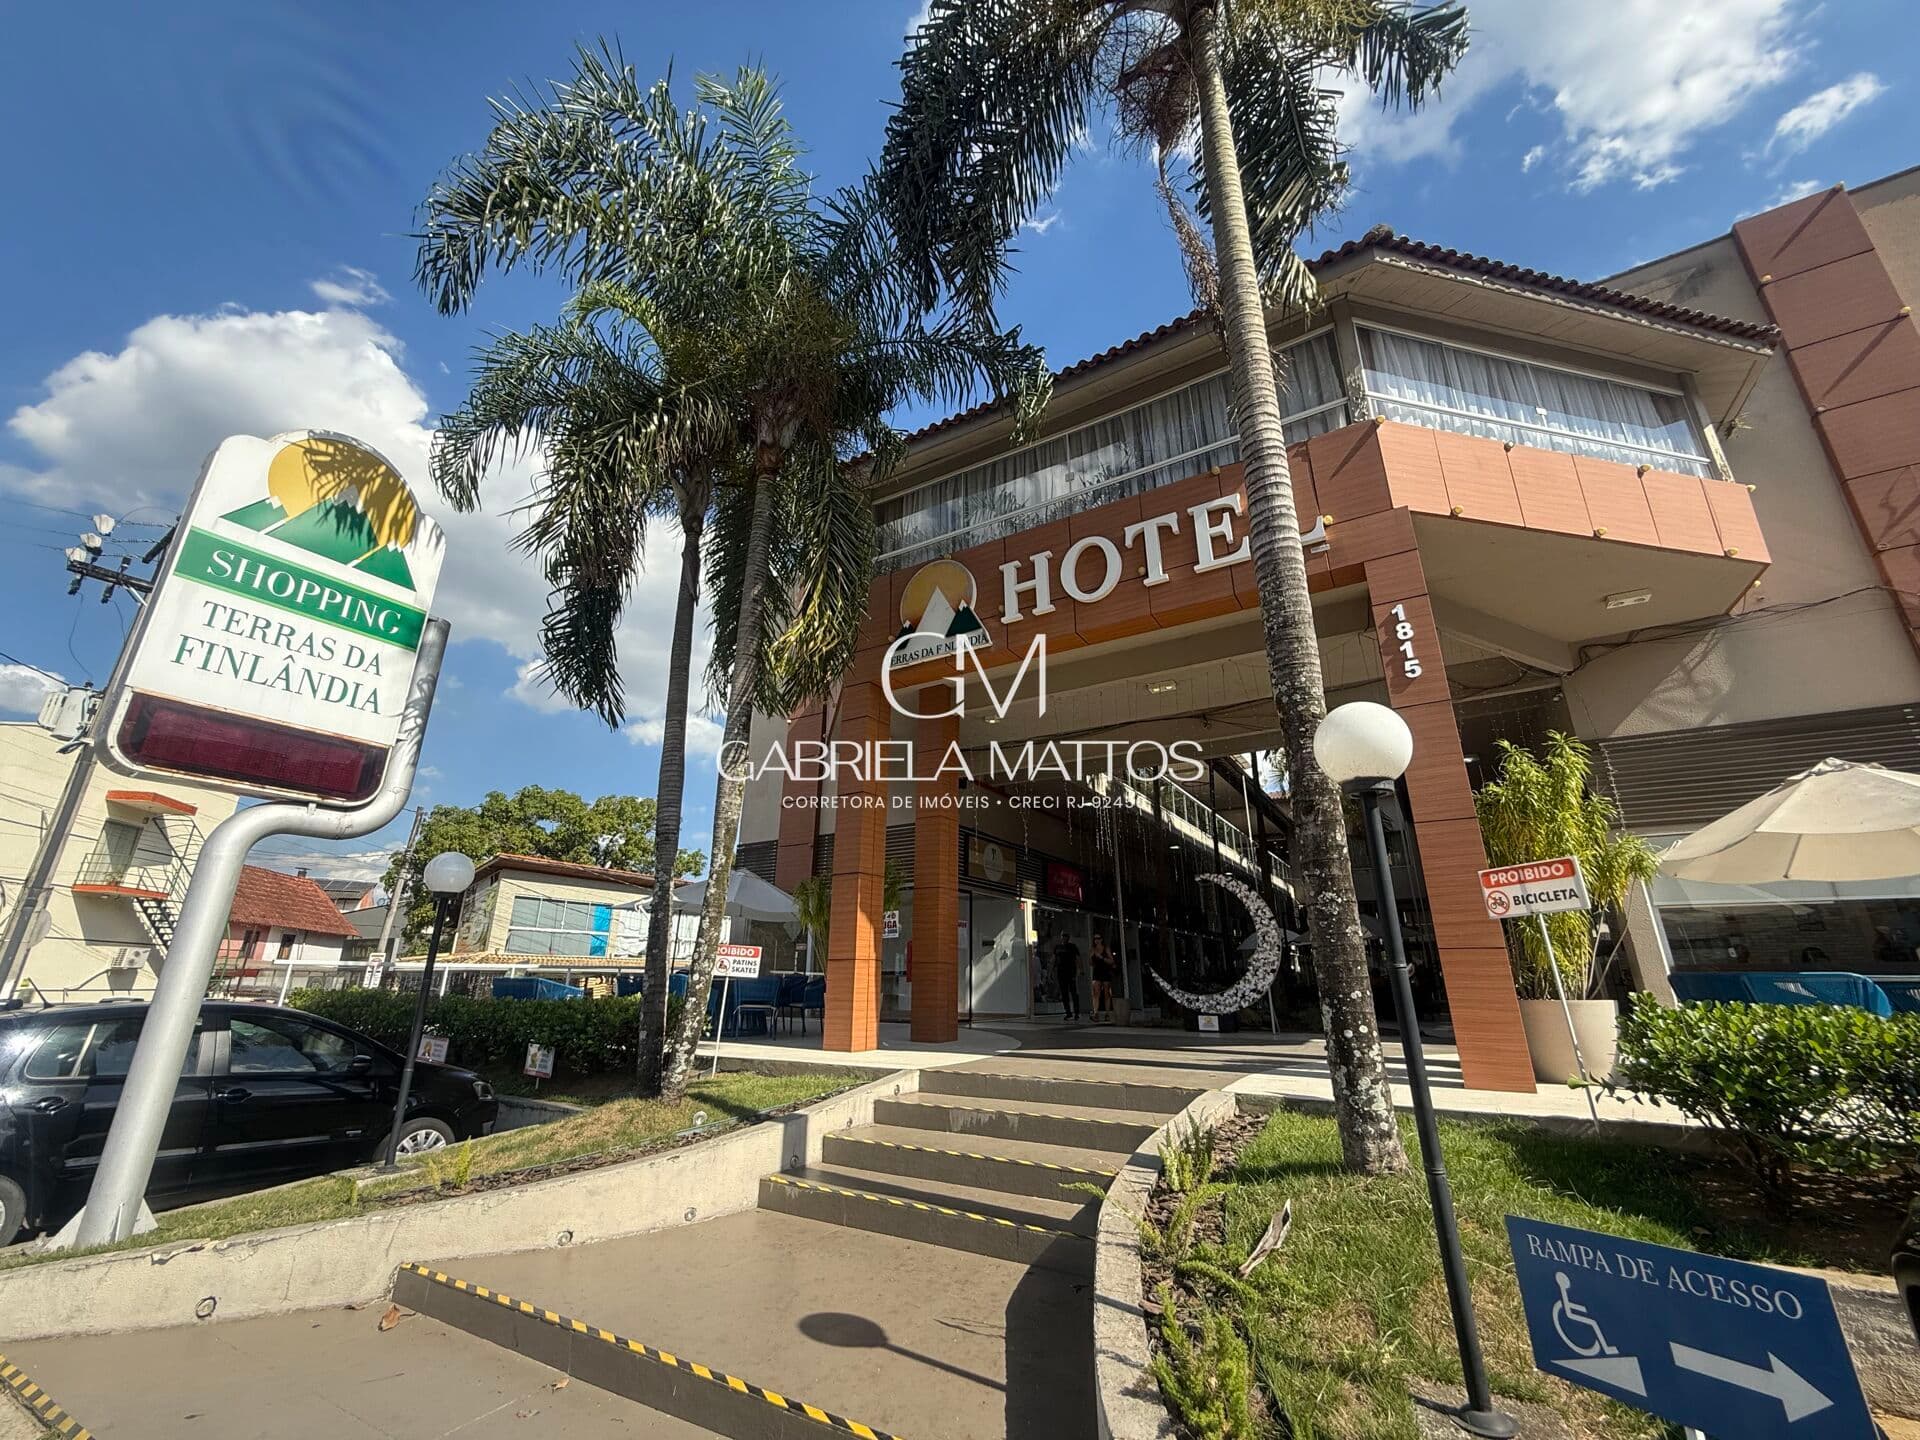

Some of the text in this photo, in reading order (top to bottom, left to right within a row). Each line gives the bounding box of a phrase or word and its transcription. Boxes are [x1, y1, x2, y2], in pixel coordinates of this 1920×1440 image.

[206, 549, 402, 635] SHOPPING
[998, 494, 1328, 625] HOTE
[170, 634, 382, 715] FINLÂNDIA
[202, 600, 384, 677] TERRAS DA
[888, 650, 920, 666] ERRAS
[921, 647, 934, 658] DA
[1391, 604, 1422, 678] 1815
[1489, 863, 1565, 886] PROIBIDO
[1512, 888, 1579, 906] BICICLETA
[731, 966, 757, 974] SKATES
[1526, 1233, 1803, 1320] RAMPA DE ACESSO
